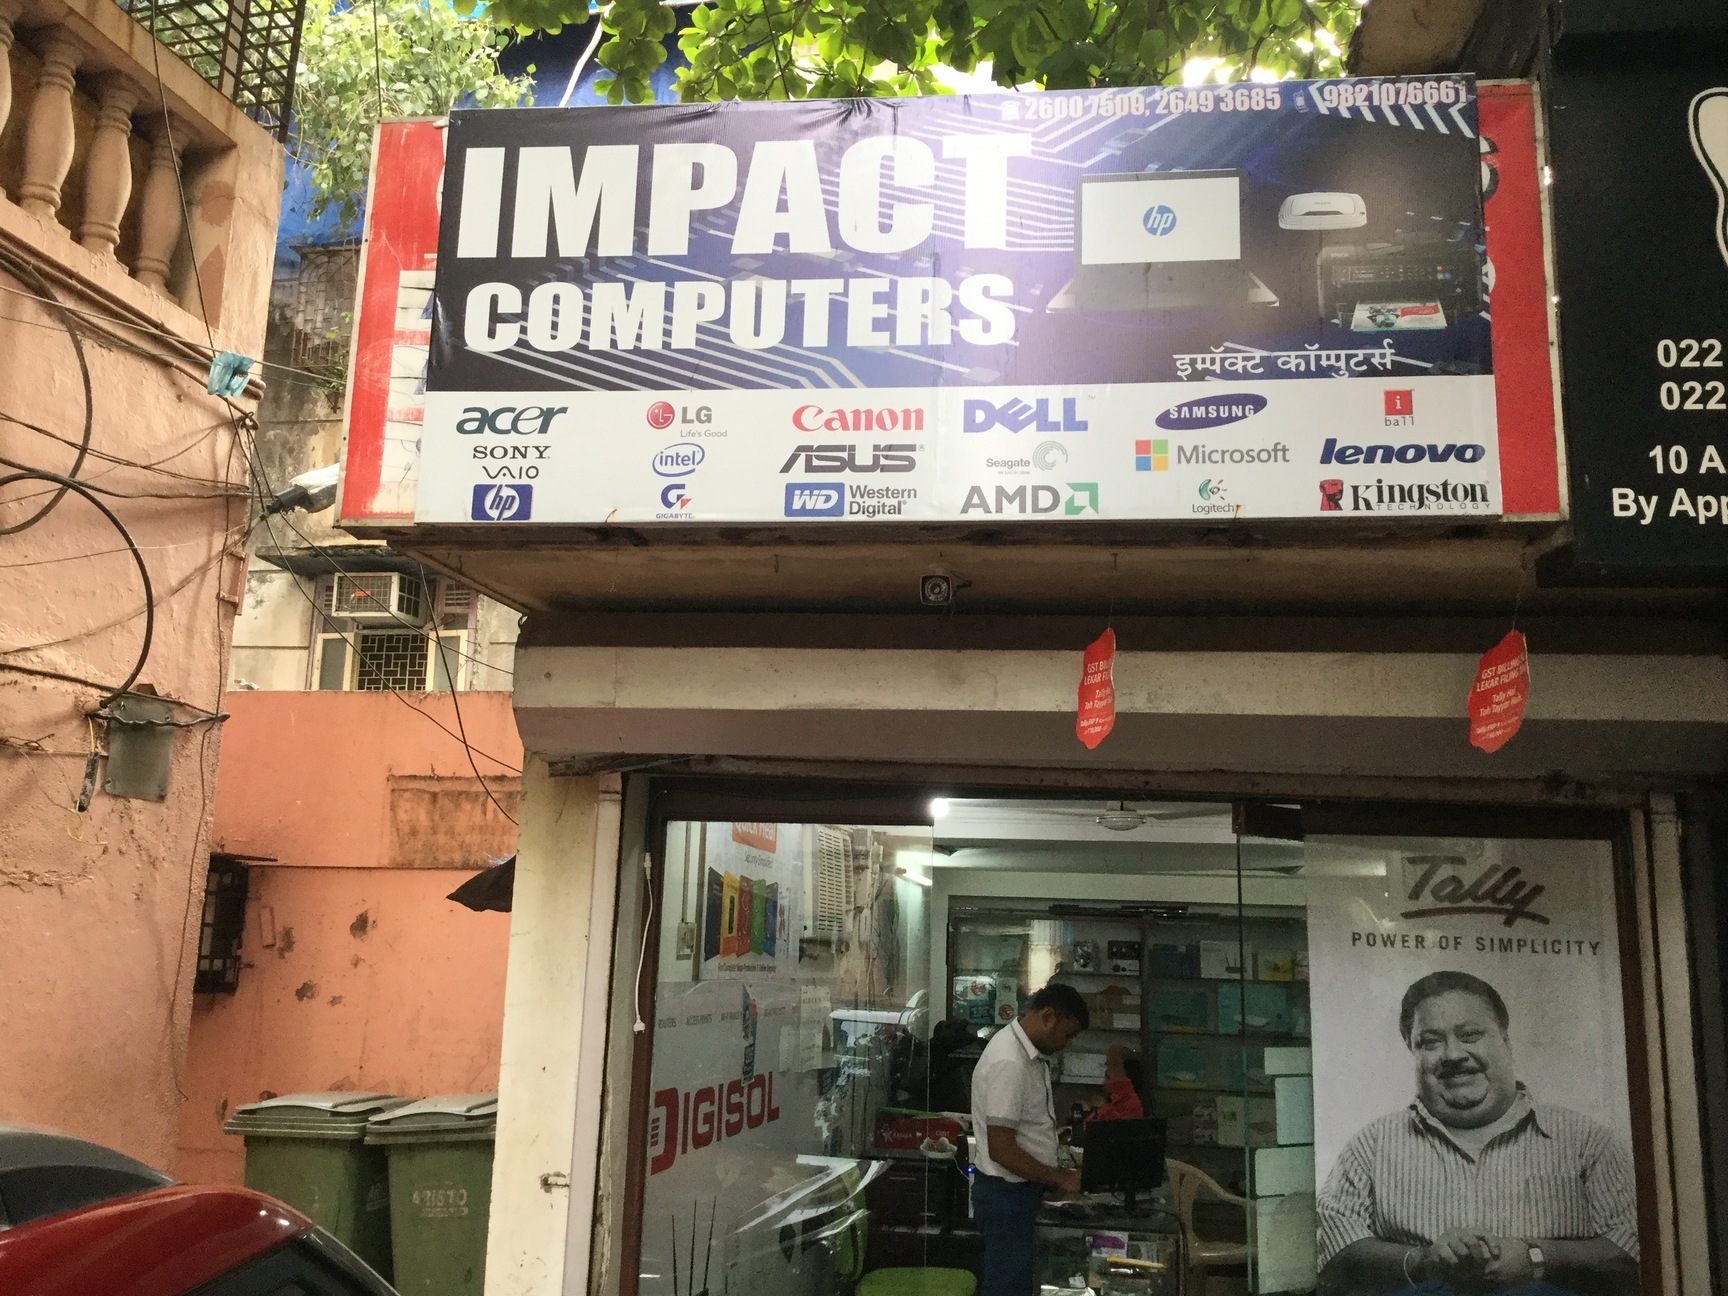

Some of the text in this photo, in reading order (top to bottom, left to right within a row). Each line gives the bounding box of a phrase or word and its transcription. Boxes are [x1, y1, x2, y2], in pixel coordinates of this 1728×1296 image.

[1024, 95, 1084, 119] 2600
[1155, 90, 1215, 114] 2649
[1220, 88, 1281, 112] 3685
[1323, 81, 1468, 109] 9821076661
[457, 133, 1032, 259] IMPACT
[1146, 205, 1174, 236] hp
[464, 273, 1015, 352] COMPUTERS
[1657, 338, 1724, 368] 022
[1660, 380, 1727, 411] 022
[456, 406, 569, 436] acer
[681, 405, 713, 424] LG
[792, 404, 924, 433] Canon
[963, 397, 1089, 434] DELL
[1169, 404, 1256, 420] SAMSUNG
[1384, 416, 1415, 427] ball
[680, 429, 728, 438] Life's Good
[472, 445, 552, 460] SONY
[659, 450, 697, 467] intel
[778, 443, 918, 474] ASUS
[985, 458, 1031, 470] Seagate
[1177, 441, 1290, 465] Microsoft
[1319, 437, 1486, 465] lenovo
[1648, 445, 1689, 475] 10
[481, 465, 540, 480] VAIO
[488, 484, 517, 521] hp
[792, 489, 839, 510] WD
[849, 484, 918, 499] Western
[959, 485, 1061, 515] AMD
[1350, 478, 1490, 512] Kingston
[656, 512, 694, 520] GIGABYTE
[849, 499, 903, 519] Digital
[1191, 503, 1235, 516] Logitech
[1376, 502, 1491, 511] TECHNOLOGY
[1611, 487, 1659, 526] By
[1087, 661, 1099, 674] GST
[1481, 666, 1497, 680] GST
[1476, 676, 1500, 692] LEKAR
[1403, 855, 1547, 929] Tally
[1351, 931, 1601, 956] POWER OF SIMPLICITY
[650, 1071, 780, 1176] DIGISOL
